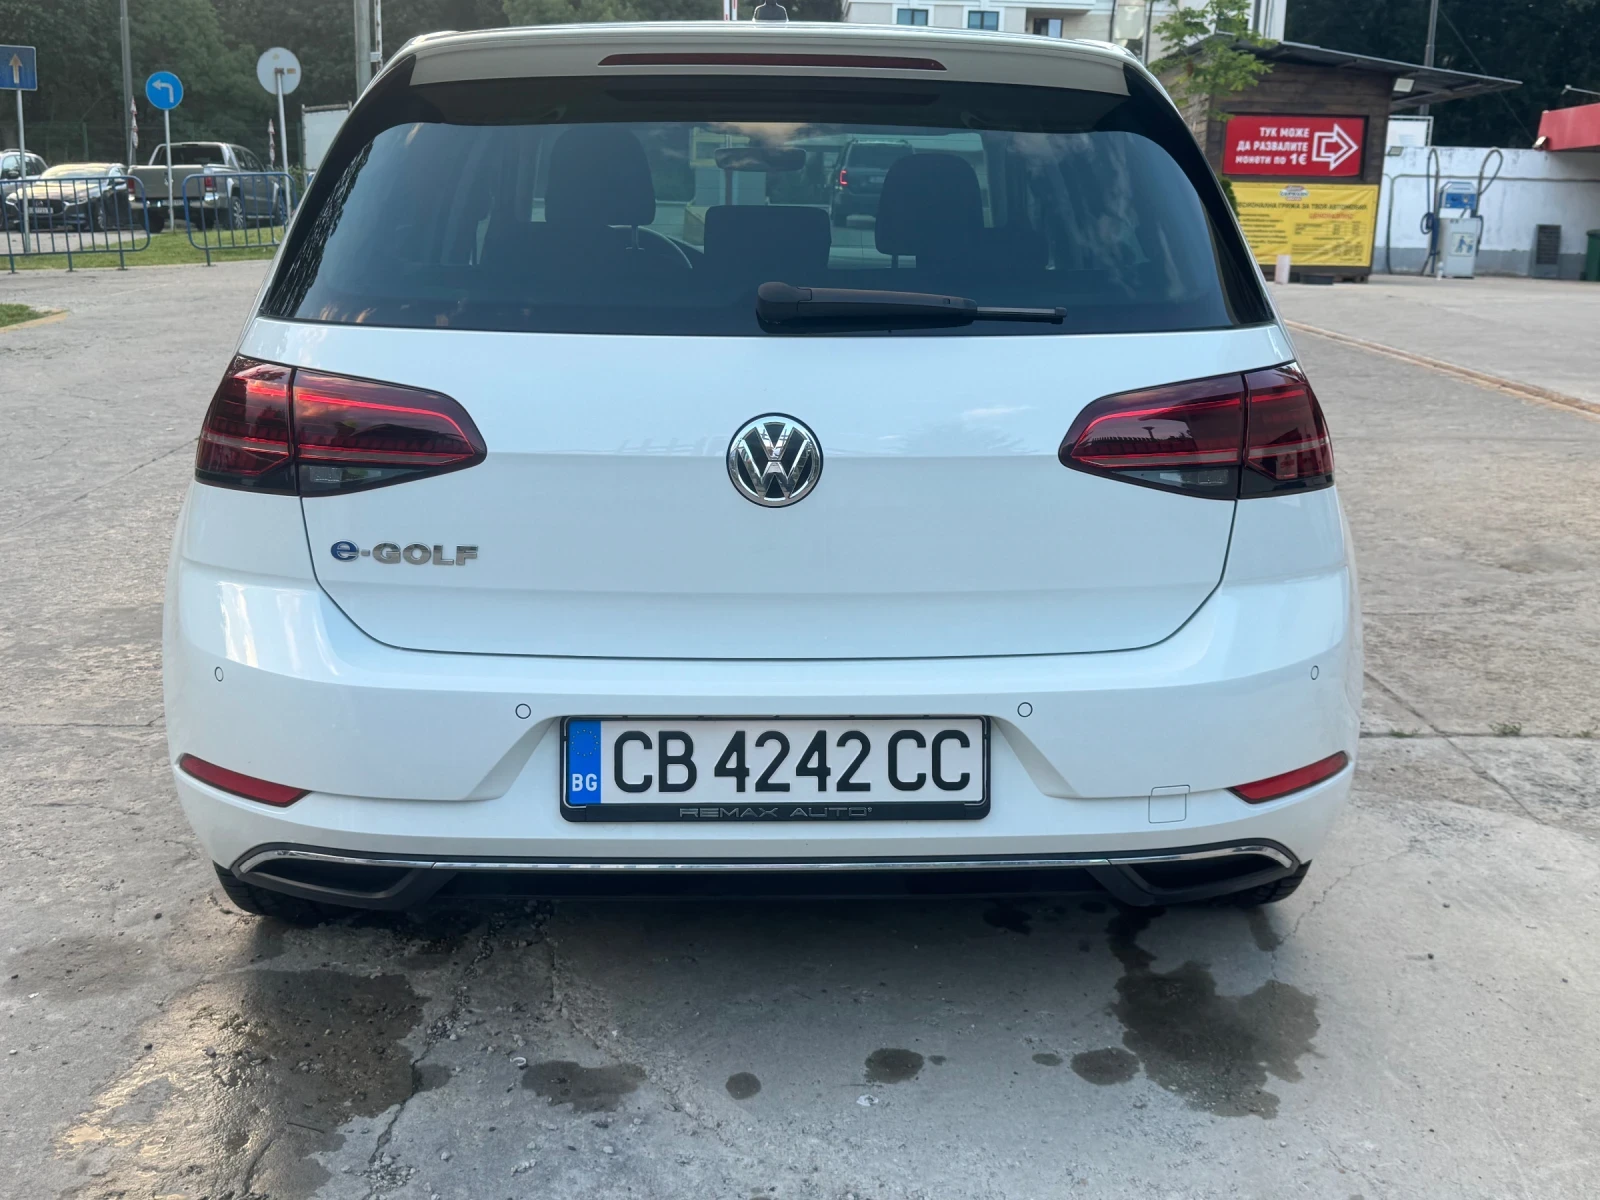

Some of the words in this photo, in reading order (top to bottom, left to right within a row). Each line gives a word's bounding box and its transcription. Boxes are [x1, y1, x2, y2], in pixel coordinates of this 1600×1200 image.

[1259, 127, 1277, 137] ТУК
[1279, 128, 1310, 138] МОЖЕ
[1236, 140, 1251, 152] ДА
[1253, 140, 1309, 152] РАЗВАЛИТЕ
[1289, 153, 1308, 165] 1€
[330, 539, 479, 566] e-GOLF
[613, 730, 698, 794] CB
[714, 730, 871, 793] 4242
[887, 729, 971, 792] CC
[571, 773, 598, 792] BG
[679, 807, 779, 818] REMAX
